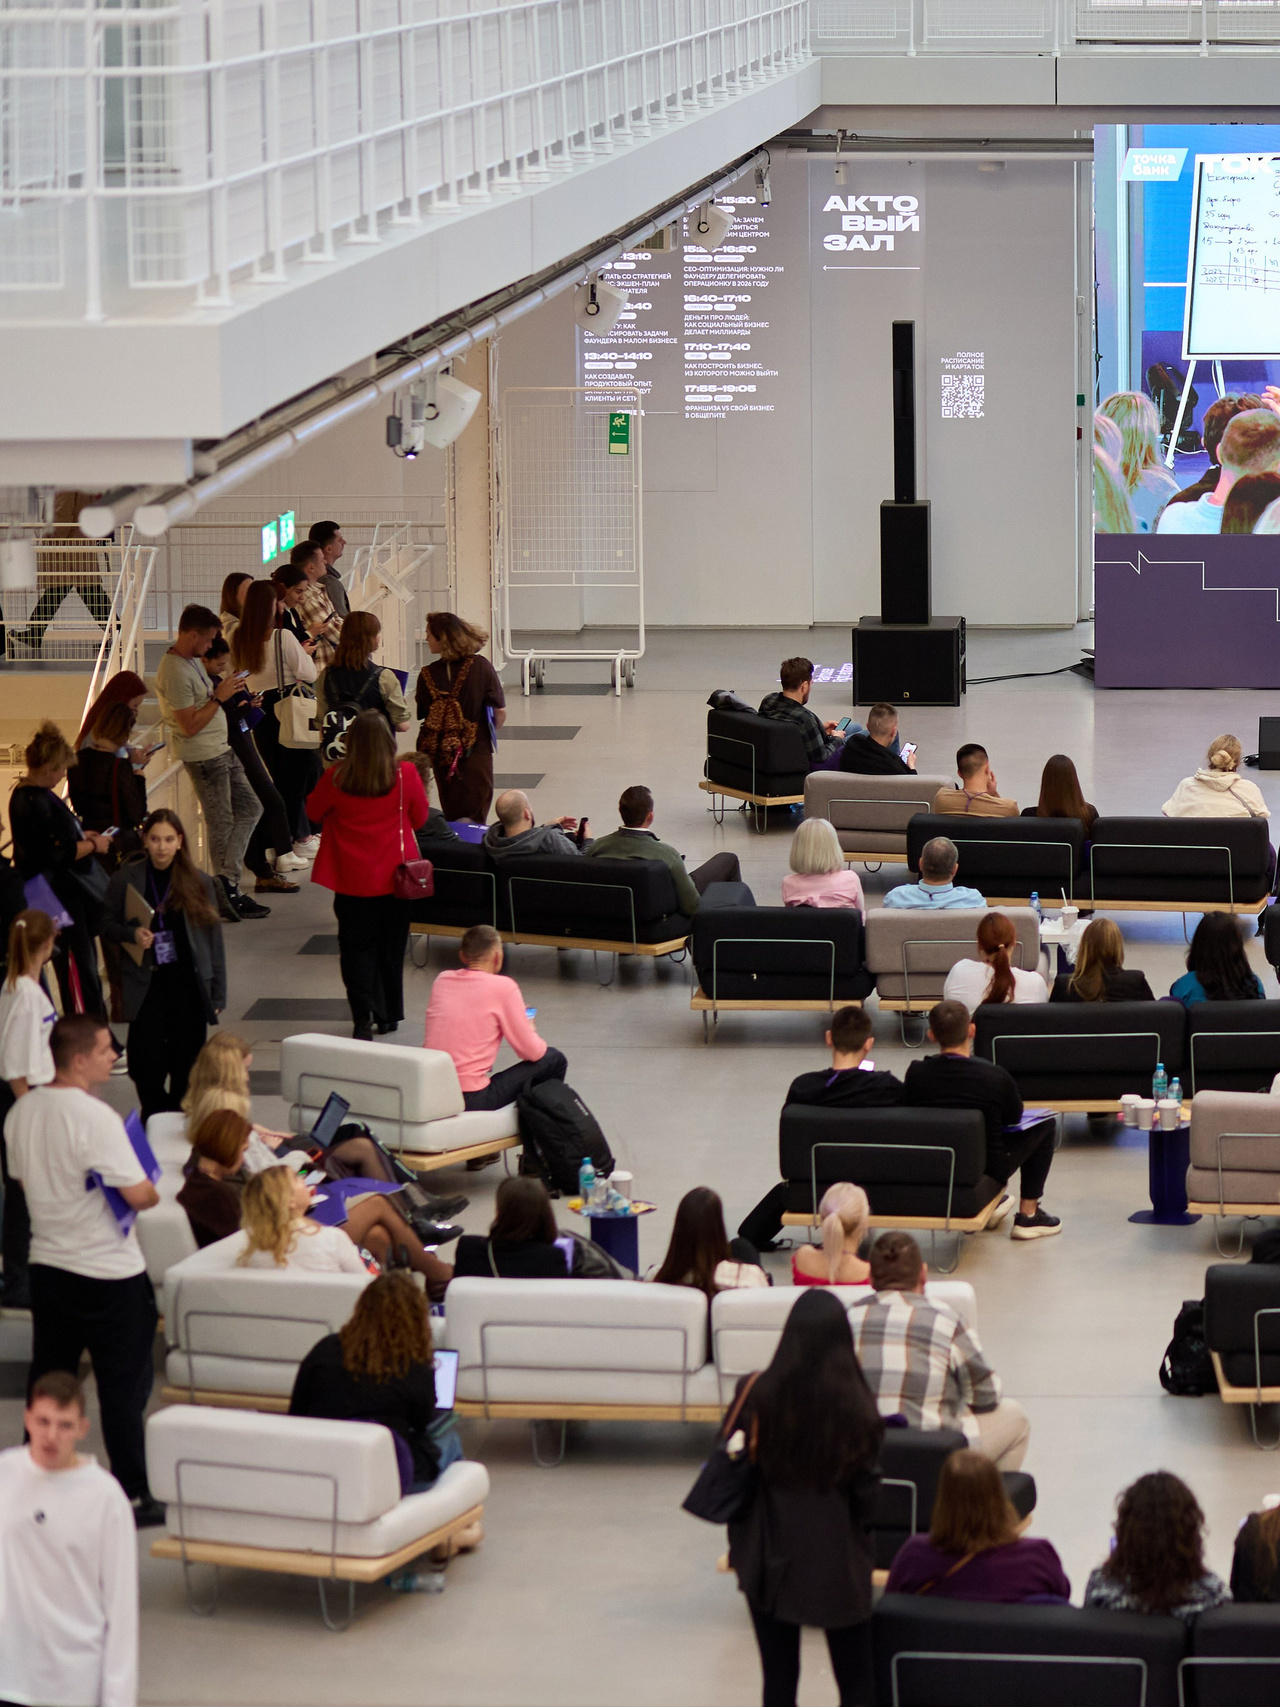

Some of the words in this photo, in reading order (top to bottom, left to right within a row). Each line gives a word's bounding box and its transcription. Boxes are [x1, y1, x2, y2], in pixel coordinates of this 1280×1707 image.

[1132, 154, 1176, 164] точка
[1132, 163, 1170, 176] банк
[822, 195, 919, 212] АКТО
[842, 211, 920, 232] ВЫЙ
[823, 234, 895, 251] ЗАЛ
